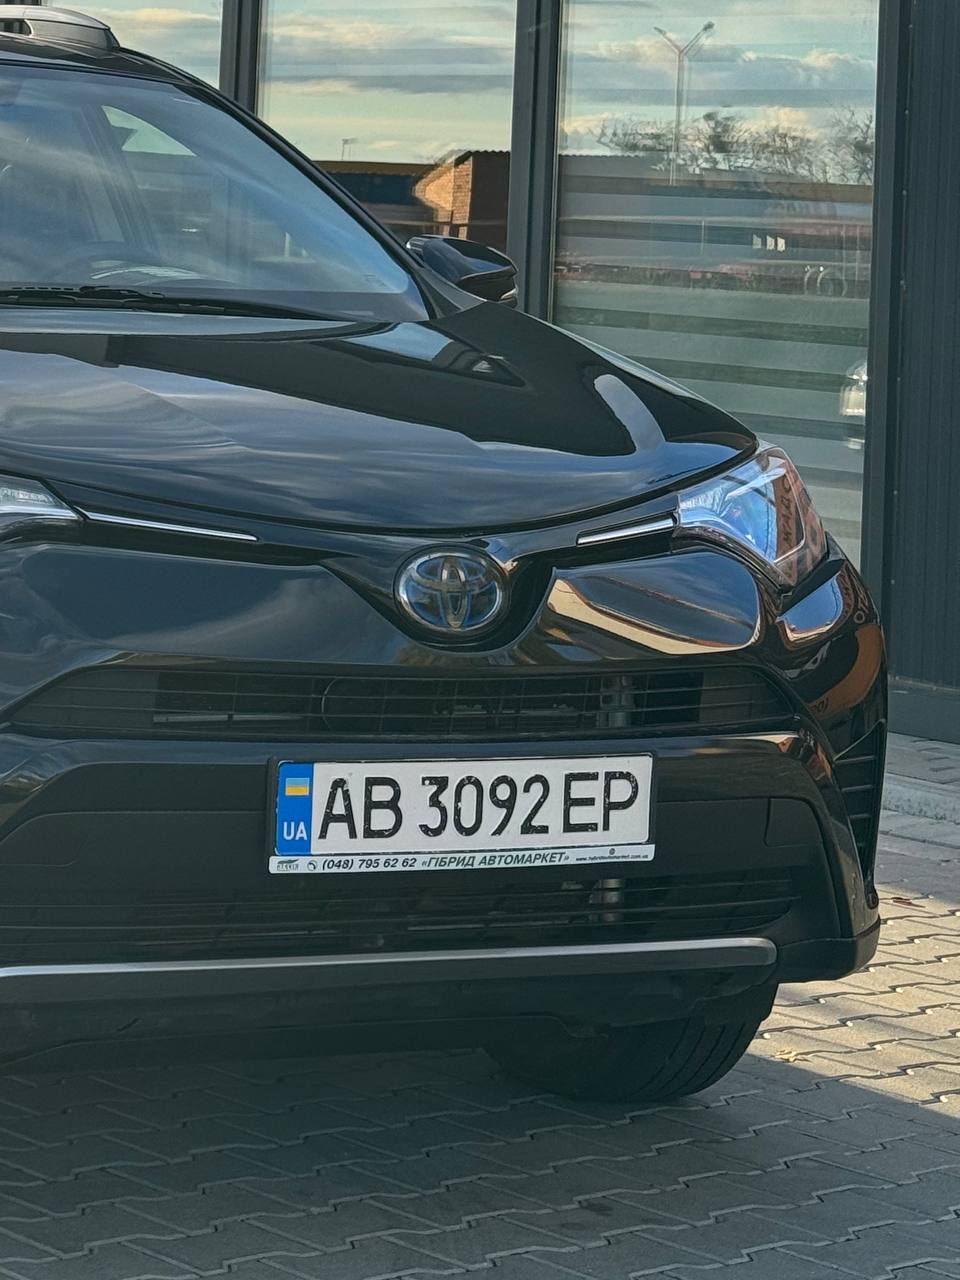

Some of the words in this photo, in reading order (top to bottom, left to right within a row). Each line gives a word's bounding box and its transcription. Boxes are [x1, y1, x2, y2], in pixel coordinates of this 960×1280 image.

[317, 776, 403, 840] AB
[418, 773, 550, 837] 3092
[562, 770, 639, 833] EP
[283, 821, 308, 841] UA
[322, 858, 354, 871] (048)
[358, 858, 380, 869] 795
[383, 858, 398, 869] 62
[401, 857, 418, 868] 62
